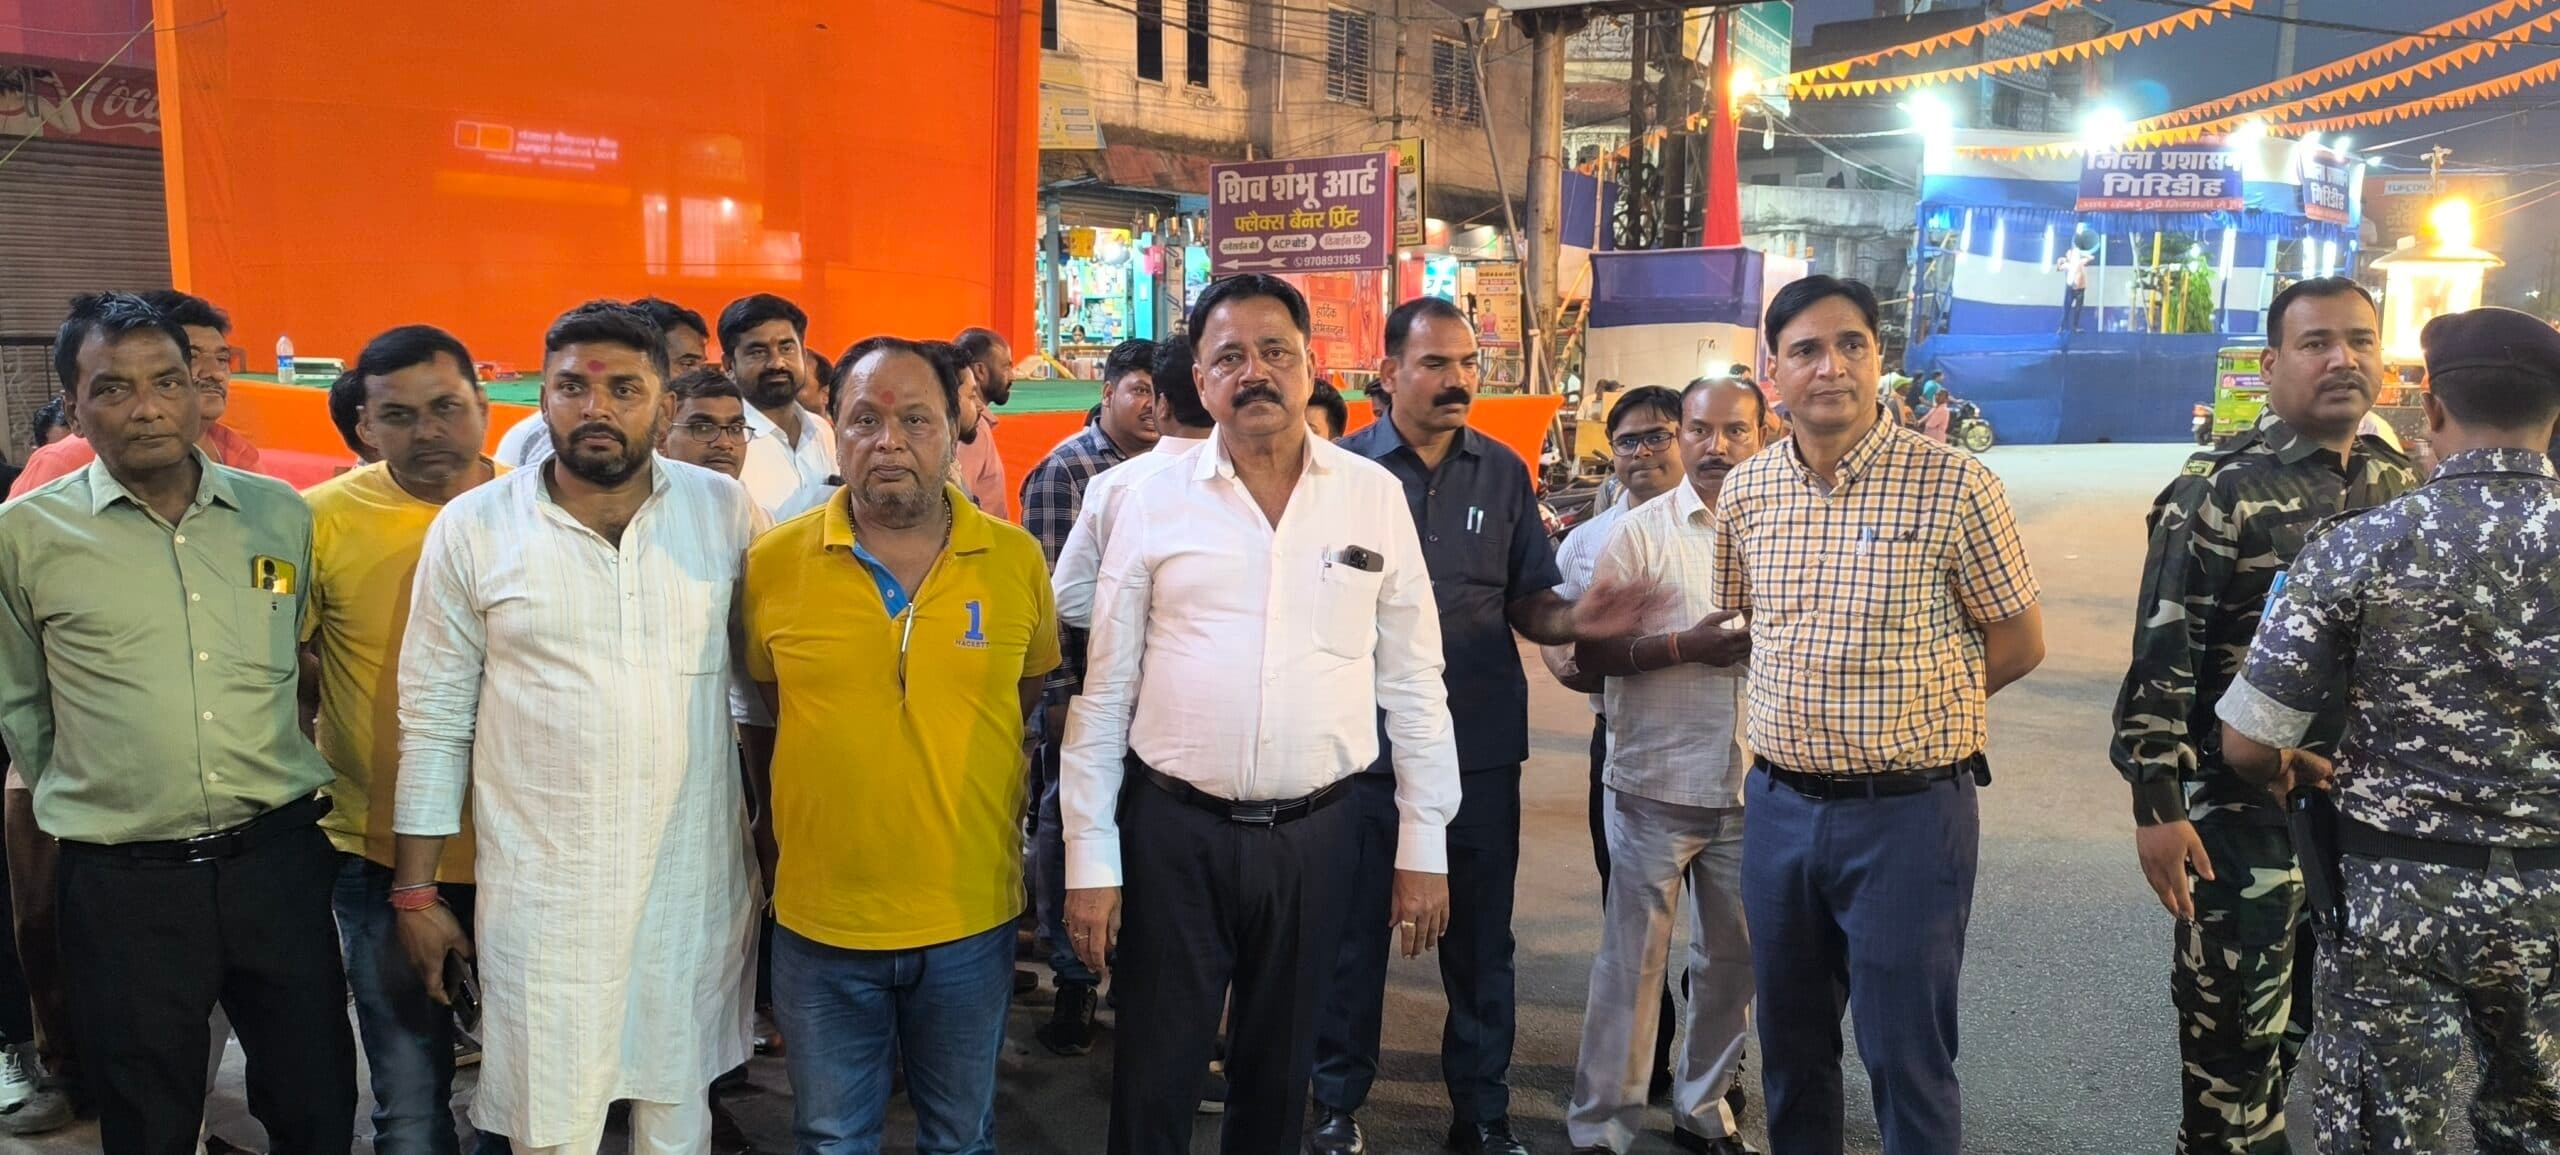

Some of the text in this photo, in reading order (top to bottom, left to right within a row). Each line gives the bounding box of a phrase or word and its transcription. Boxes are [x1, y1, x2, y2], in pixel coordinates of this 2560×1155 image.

[1218, 158, 1379, 209] शिव शंभू आर्ट
[2103, 172, 2225, 197] गिरिडीह
[2311, 182, 2344, 210] गिरिडीह
[1234, 204, 1361, 232] फ्लैक्स बैनर प्रिंट
[1273, 240, 1291, 249] ACP
[965, 600, 984, 640] 1
